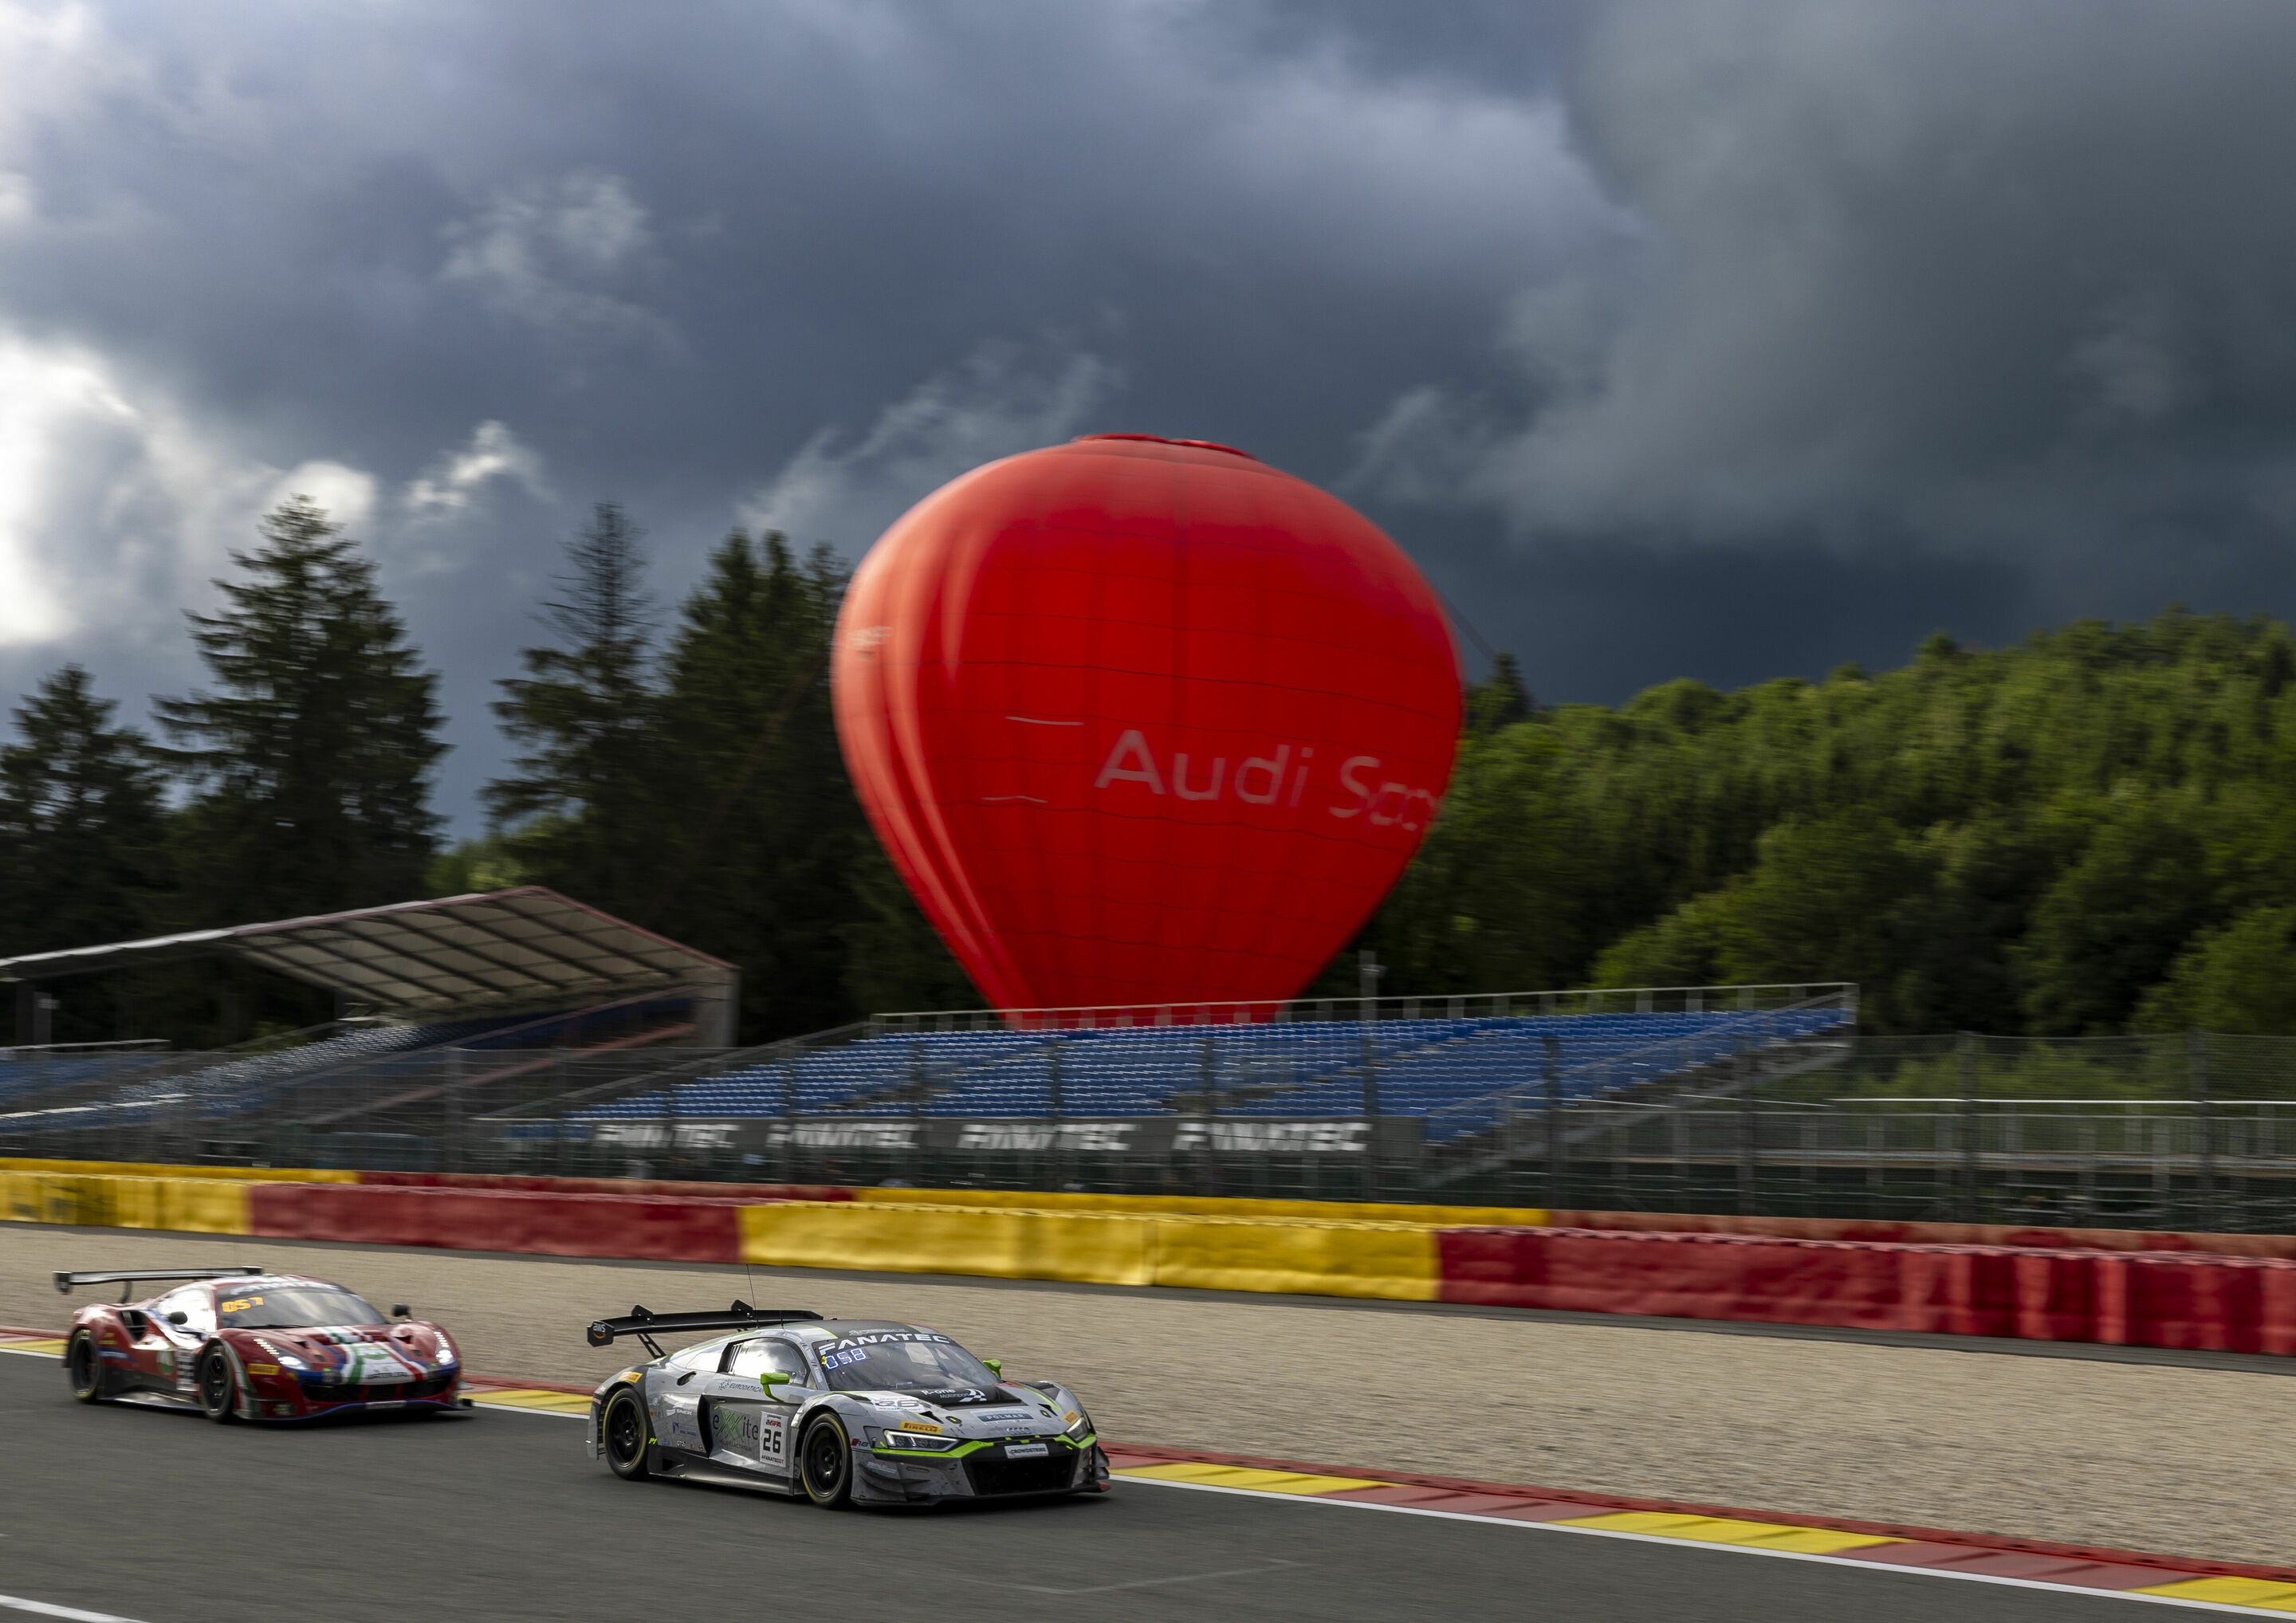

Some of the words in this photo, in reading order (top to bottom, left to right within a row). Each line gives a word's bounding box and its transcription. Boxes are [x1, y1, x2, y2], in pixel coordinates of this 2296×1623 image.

[1093, 729, 1314, 808] Audi
[818, 1333, 951, 1356] FANATEC
[902, 1422, 939, 1432] PIRELLI
[763, 1428, 782, 1455] 26
